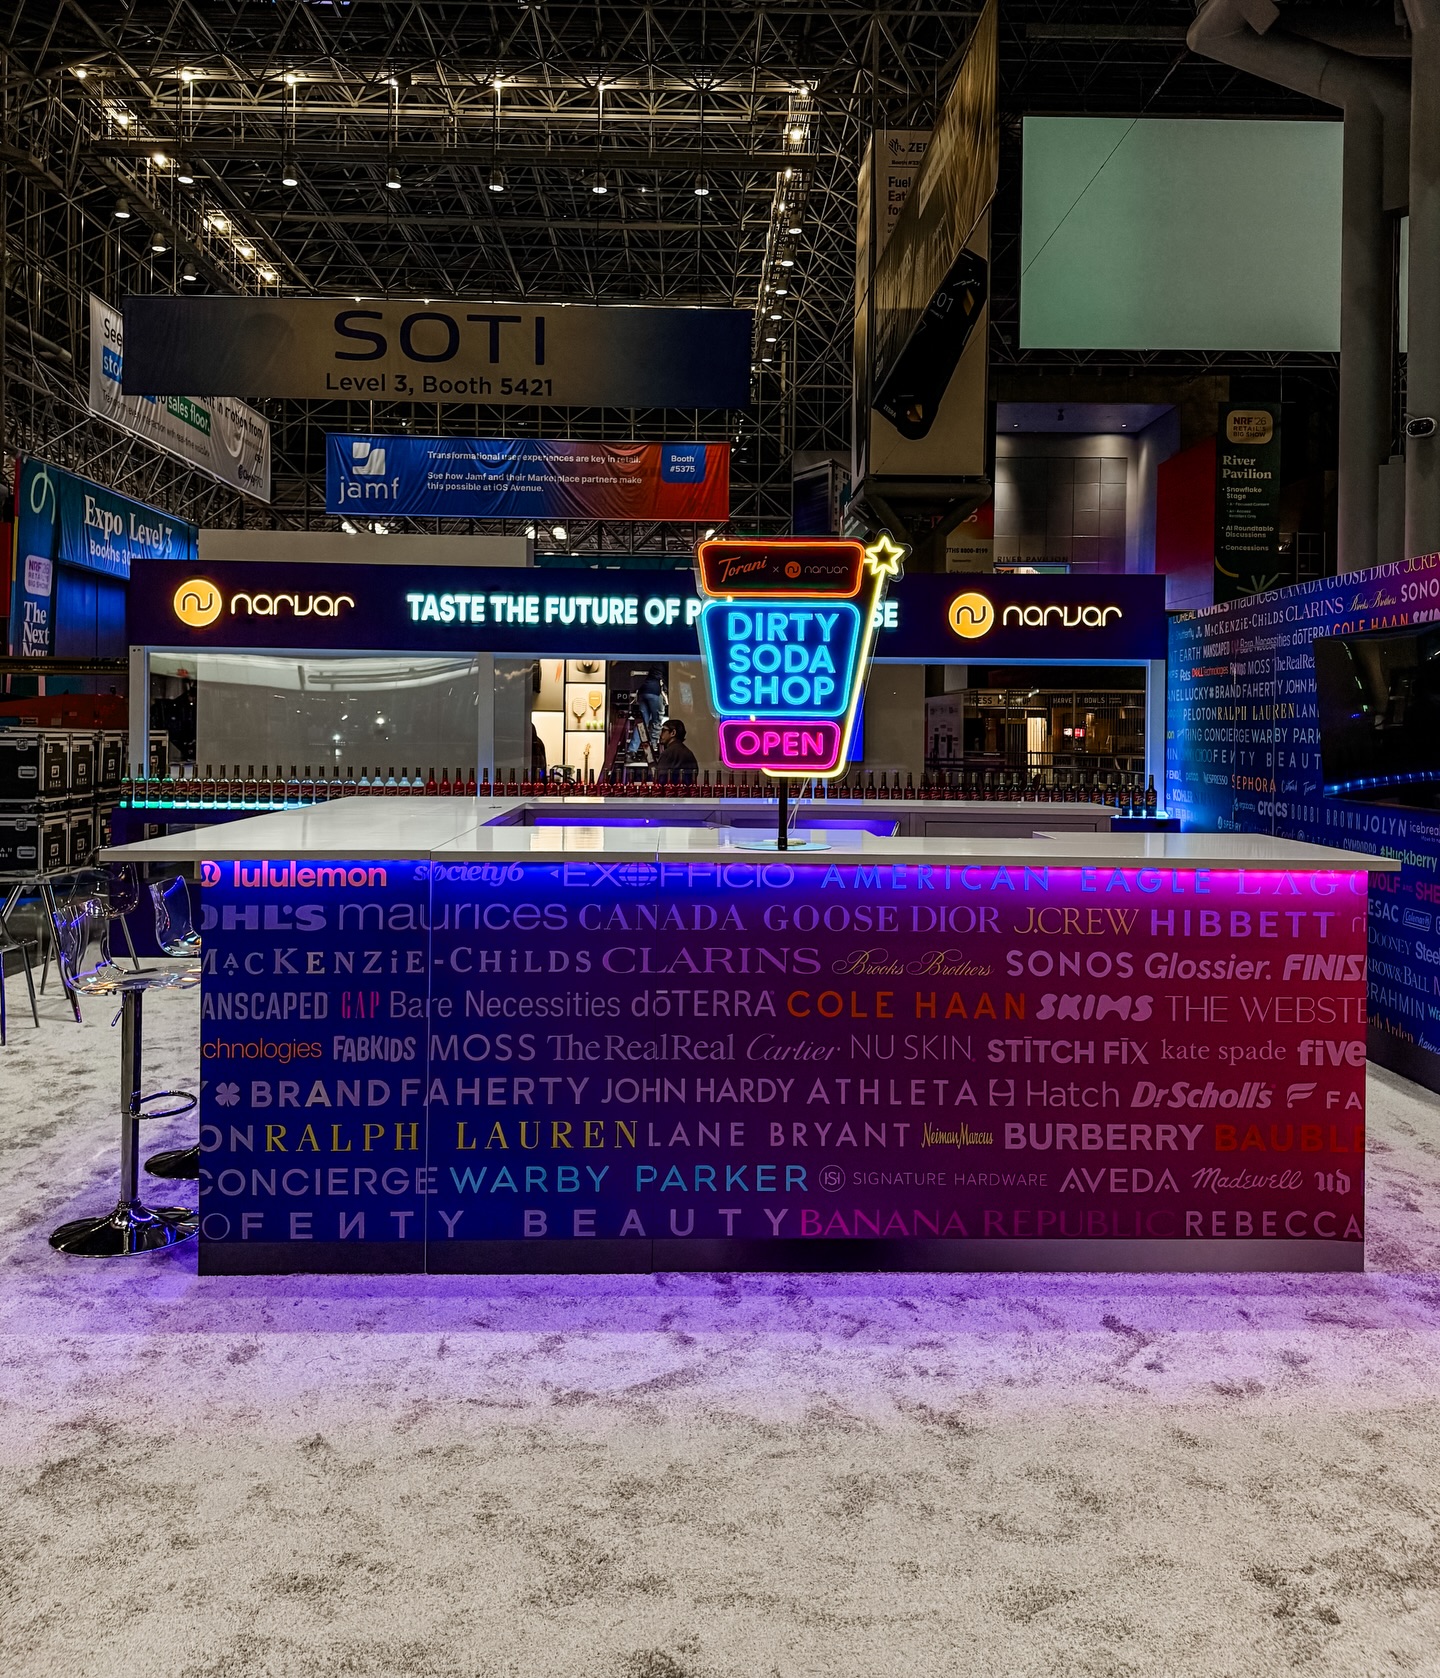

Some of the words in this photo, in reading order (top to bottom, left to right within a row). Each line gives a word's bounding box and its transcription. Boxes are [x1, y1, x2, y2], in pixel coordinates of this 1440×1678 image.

[888, 177, 911, 187] Fuel
[104, 319, 122, 347] See
[334, 310, 545, 365] SOTI
[326, 373, 386, 391] Level
[393, 374, 414, 395] 3,
[423, 375, 491, 395] Booth
[500, 378, 553, 396] 5421
[168, 396, 188, 418] sales
[1233, 417, 1253, 425] NRF
[427, 451, 500, 461] Transformational
[522, 454, 574, 464] experiences
[591, 455, 605, 464] key
[670, 465, 695, 473] #5375
[671, 455, 694, 463] Booth
[1222, 455, 1256, 465] River
[428, 472, 443, 480] See
[445, 472, 463, 480] how
[465, 472, 486, 481] Jamf
[488, 473, 504, 481] and
[506, 473, 526, 481] their
[527, 474, 580, 484] Marketplace
[582, 476, 617, 484] partners
[619, 476, 642, 484] make
[1222, 468, 1272, 479] Pavilion
[338, 476, 399, 504] jamf
[427, 482, 443, 490] this
[446, 483, 481, 491] possible
[494, 483, 508, 491] iOS
[510, 483, 544, 492] Avenue.
[84, 494, 123, 539] Expo
[129, 512, 163, 550] Level
[90, 539, 120, 563] Booths
[719, 555, 768, 582] Torani
[805, 566, 849, 574] narvar
[231, 593, 354, 616] narvar
[407, 593, 484, 623] TASTE
[490, 594, 539, 624] THE
[546, 596, 638, 625] FUTURE
[645, 598, 681, 625] OF
[1285, 597, 1344, 622] CLARINS
[1401, 578, 1440, 602] SONO
[24, 601, 46, 624] The
[1003, 605, 1122, 626] narvar
[23, 622, 50, 645] Next
[727, 612, 839, 641] DIRTY
[22, 642, 48, 657] Now
[728, 644, 836, 673] SODA
[1248, 659, 1270, 674] MOSS
[729, 676, 835, 705] SHOP
[1185, 686, 1208, 700] LUCKY
[1215, 684, 1241, 699] BRAND
[1242, 680, 1283, 698] FAHERTY
[1285, 679, 1307, 694] JOHN
[1183, 707, 1217, 720] PELOTON
[1218, 706, 1246, 720] RALPH
[1253, 703, 1295, 720] LAUREN
[735, 731, 824, 756] OPEN
[1185, 728, 1202, 741] RING
[1204, 728, 1249, 743] CONCIERGE
[1251, 728, 1288, 743] WARBY
[1231, 774, 1276, 792] SEPHORA
[1258, 800, 1288, 818] crocs
[1291, 804, 1319, 823] BOBBI
[1326, 809, 1360, 830] BROWN
[1363, 814, 1407, 837] JOLYN
[1386, 846, 1437, 872] Huckberry
[234, 860, 387, 887] lululemon
[821, 864, 1048, 891] AMERICAN
[1081, 867, 1211, 894] EAGLE
[1369, 872, 1400, 893] WOLF
[339, 903, 568, 931] maurices
[579, 903, 747, 931] CANADA
[764, 904, 899, 932] GOOSE
[909, 905, 1002, 933] DIOR
[1014, 905, 1140, 935] J.CREW
[1151, 909, 1335, 938] HIBBETT
[1368, 926, 1411, 955] DOONEY
[602, 947, 821, 974] CLARINS
[831, 948, 904, 976] Brooks
[905, 948, 995, 977] Brothers
[1006, 950, 1134, 977] SONOS
[1144, 952, 1271, 981] Glossier.
[201, 992, 329, 1020] ANSCAPED
[341, 991, 379, 1019] GAP
[390, 990, 452, 1019] Bare
[466, 990, 620, 1017] Necessities
[787, 991, 894, 1018] COLE
[915, 991, 1025, 1019] HAAN
[1036, 993, 1154, 1021] SKIMS
[1165, 995, 1228, 1022] THE
[202, 1038, 322, 1064] chnologies
[333, 1035, 416, 1063] FABKIDS
[430, 1033, 536, 1061] MOSS
[747, 1033, 841, 1061] Cartier
[851, 1034, 895, 1060] NU
[1160, 1038, 1210, 1060] kate
[1218, 1040, 1286, 1065] spade
[1297, 1040, 1366, 1067] five
[251, 1079, 390, 1108] BRAND
[401, 1077, 590, 1107] FAHERTY
[601, 1078, 685, 1104] JOHN
[697, 1078, 795, 1104] HARDY
[807, 1077, 978, 1106] ATHLETA
[1027, 1080, 1119, 1107] Hatch
[199, 1125, 254, 1152] ON
[265, 1122, 420, 1152] RALPH
[456, 1121, 638, 1150] LAUREN
[648, 1121, 744, 1147] LANE
[770, 1121, 910, 1147] BRYANT
[1005, 1123, 1204, 1150] BURBERRY
[450, 1165, 609, 1194] WARBY
[636, 1165, 808, 1192] PARKER
[853, 1172, 947, 1186] SIGNATURE
[954, 1172, 1047, 1187] HARDWARE
[1059, 1168, 1180, 1193] AVEDA
[1191, 1167, 1303, 1194] Madewell
[523, 1208, 789, 1237] BEAUTY
[800, 1209, 969, 1237] BANANA
[983, 1210, 1175, 1238] REPUBLIC
[1186, 1210, 1363, 1238] REBECCA
